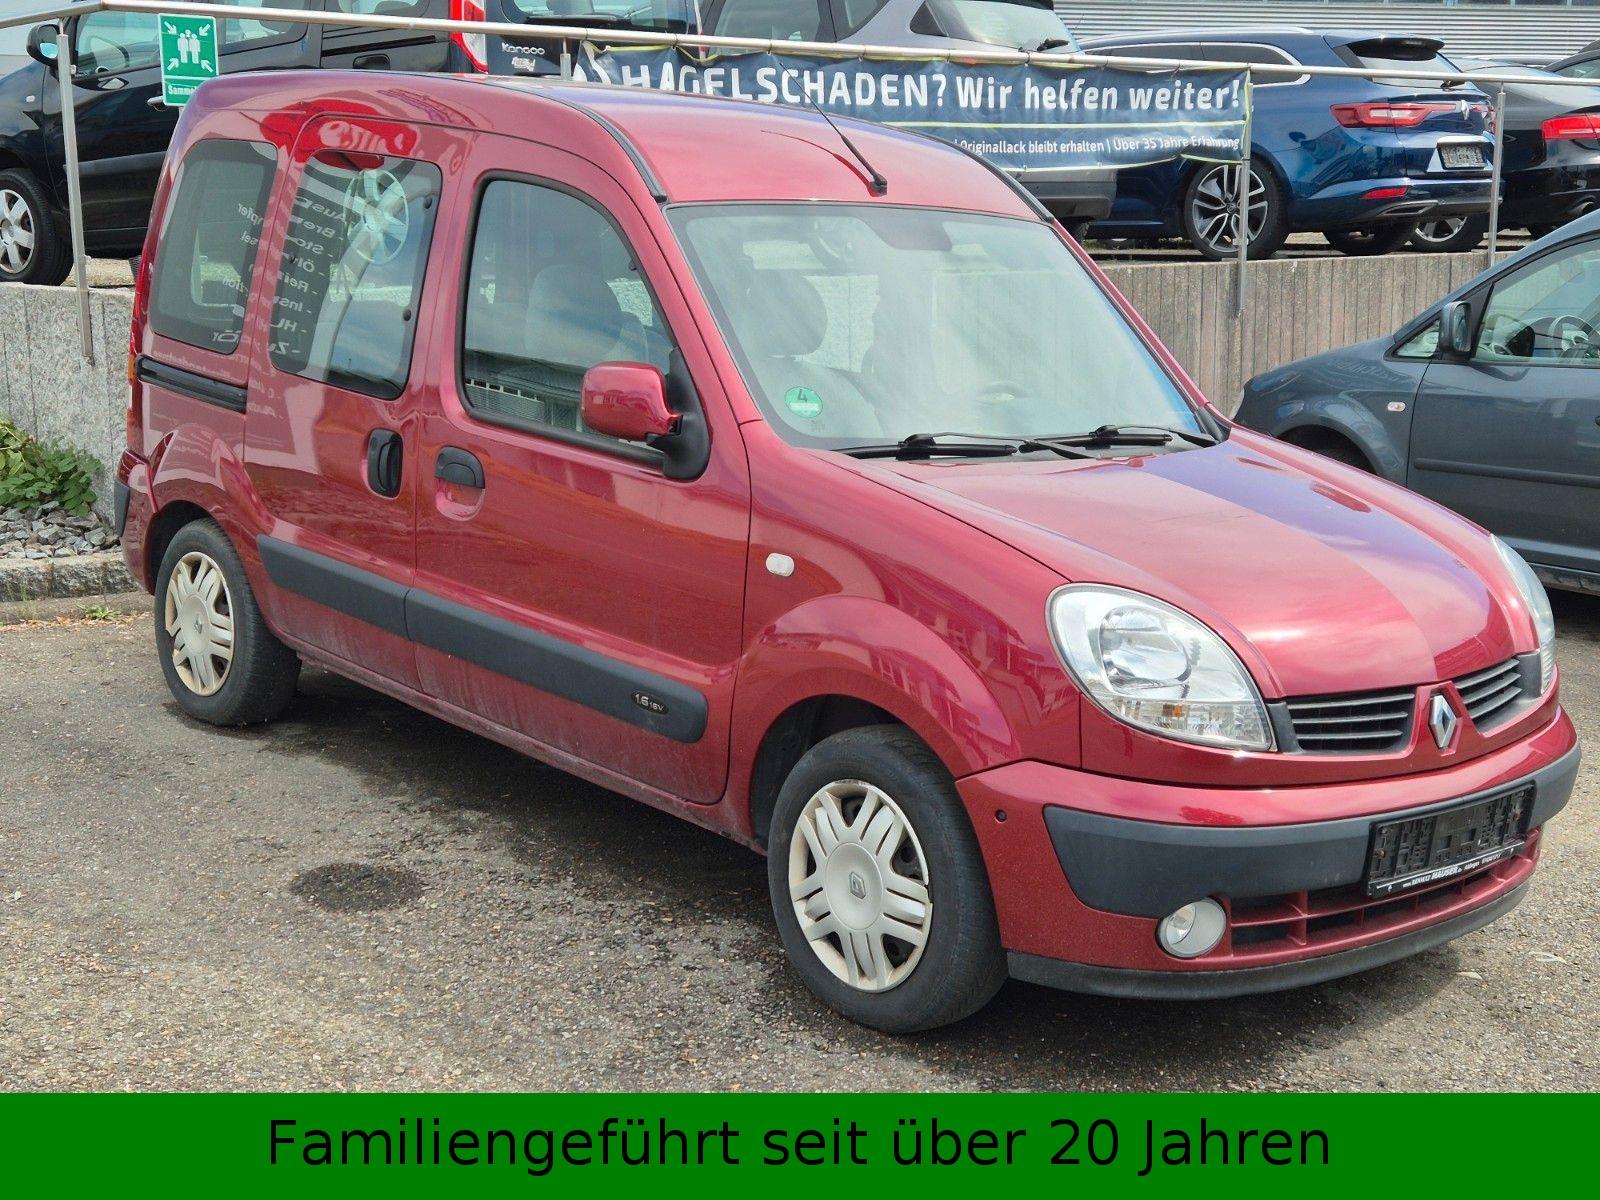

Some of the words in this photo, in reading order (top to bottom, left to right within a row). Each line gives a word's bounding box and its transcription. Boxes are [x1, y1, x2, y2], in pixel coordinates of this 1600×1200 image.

[621, 62, 947, 107] HAGELSCHADEN?
[956, 75, 1013, 109] Wir
[1025, 77, 1118, 111] helfen
[1129, 79, 1240, 110] weiter!
[960, 139, 1026, 156] Originallack
[1028, 140, 1058, 154] bleibt
[1058, 140, 1105, 153] erhalten
[1113, 136, 1140, 150] Über
[1142, 136, 1157, 148] 35
[1158, 135, 1189, 148] Jahre
[1190, 135, 1240, 150] Erfahrung
[797, 388, 808, 403] 4
